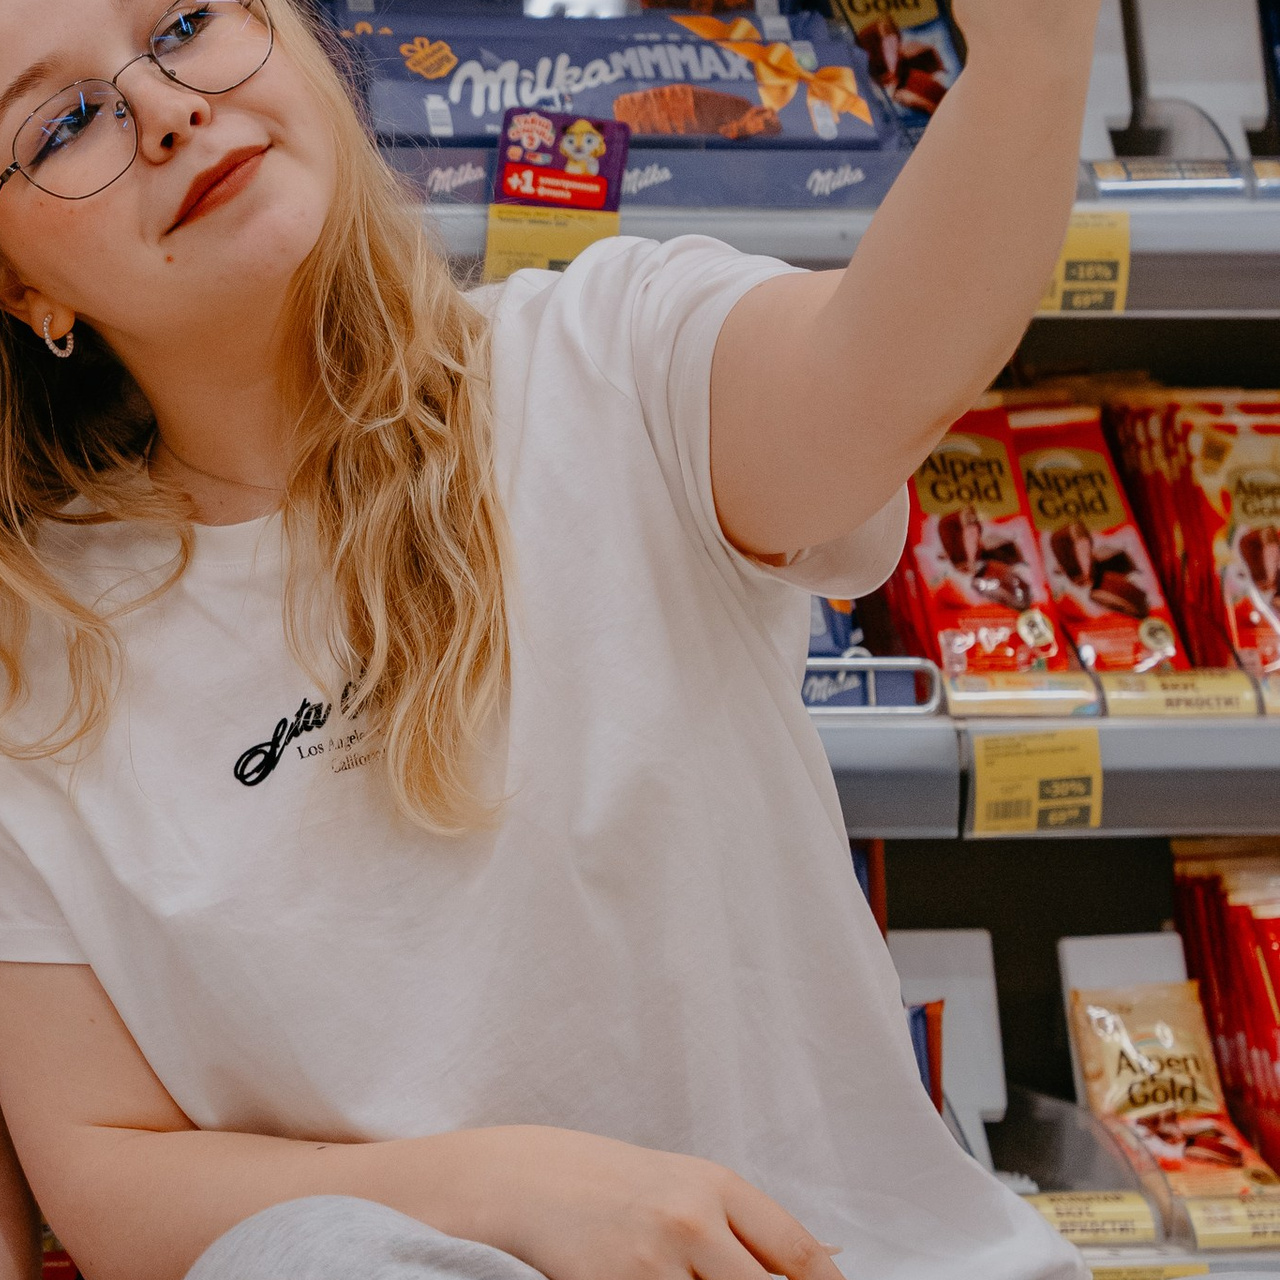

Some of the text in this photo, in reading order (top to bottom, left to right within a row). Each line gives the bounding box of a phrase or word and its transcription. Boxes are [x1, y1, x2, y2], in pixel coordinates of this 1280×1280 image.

[448, 53, 621, 117] Milka
[618, 40, 755, 81] MMMAX
[507, 169, 536, 194] +1
[806, 165, 865, 197] Milka
[921, 451, 1005, 480] Alpen
[930, 474, 1004, 504] Gold
[1025, 467, 1108, 494] Alpen
[1234, 479, 1280, 500] Alpe
[1037, 489, 1108, 519] Gold
[297, 743, 325, 760] Los
[1117, 1050, 1201, 1077] Apen
[1128, 1077, 1199, 1108] Gold
